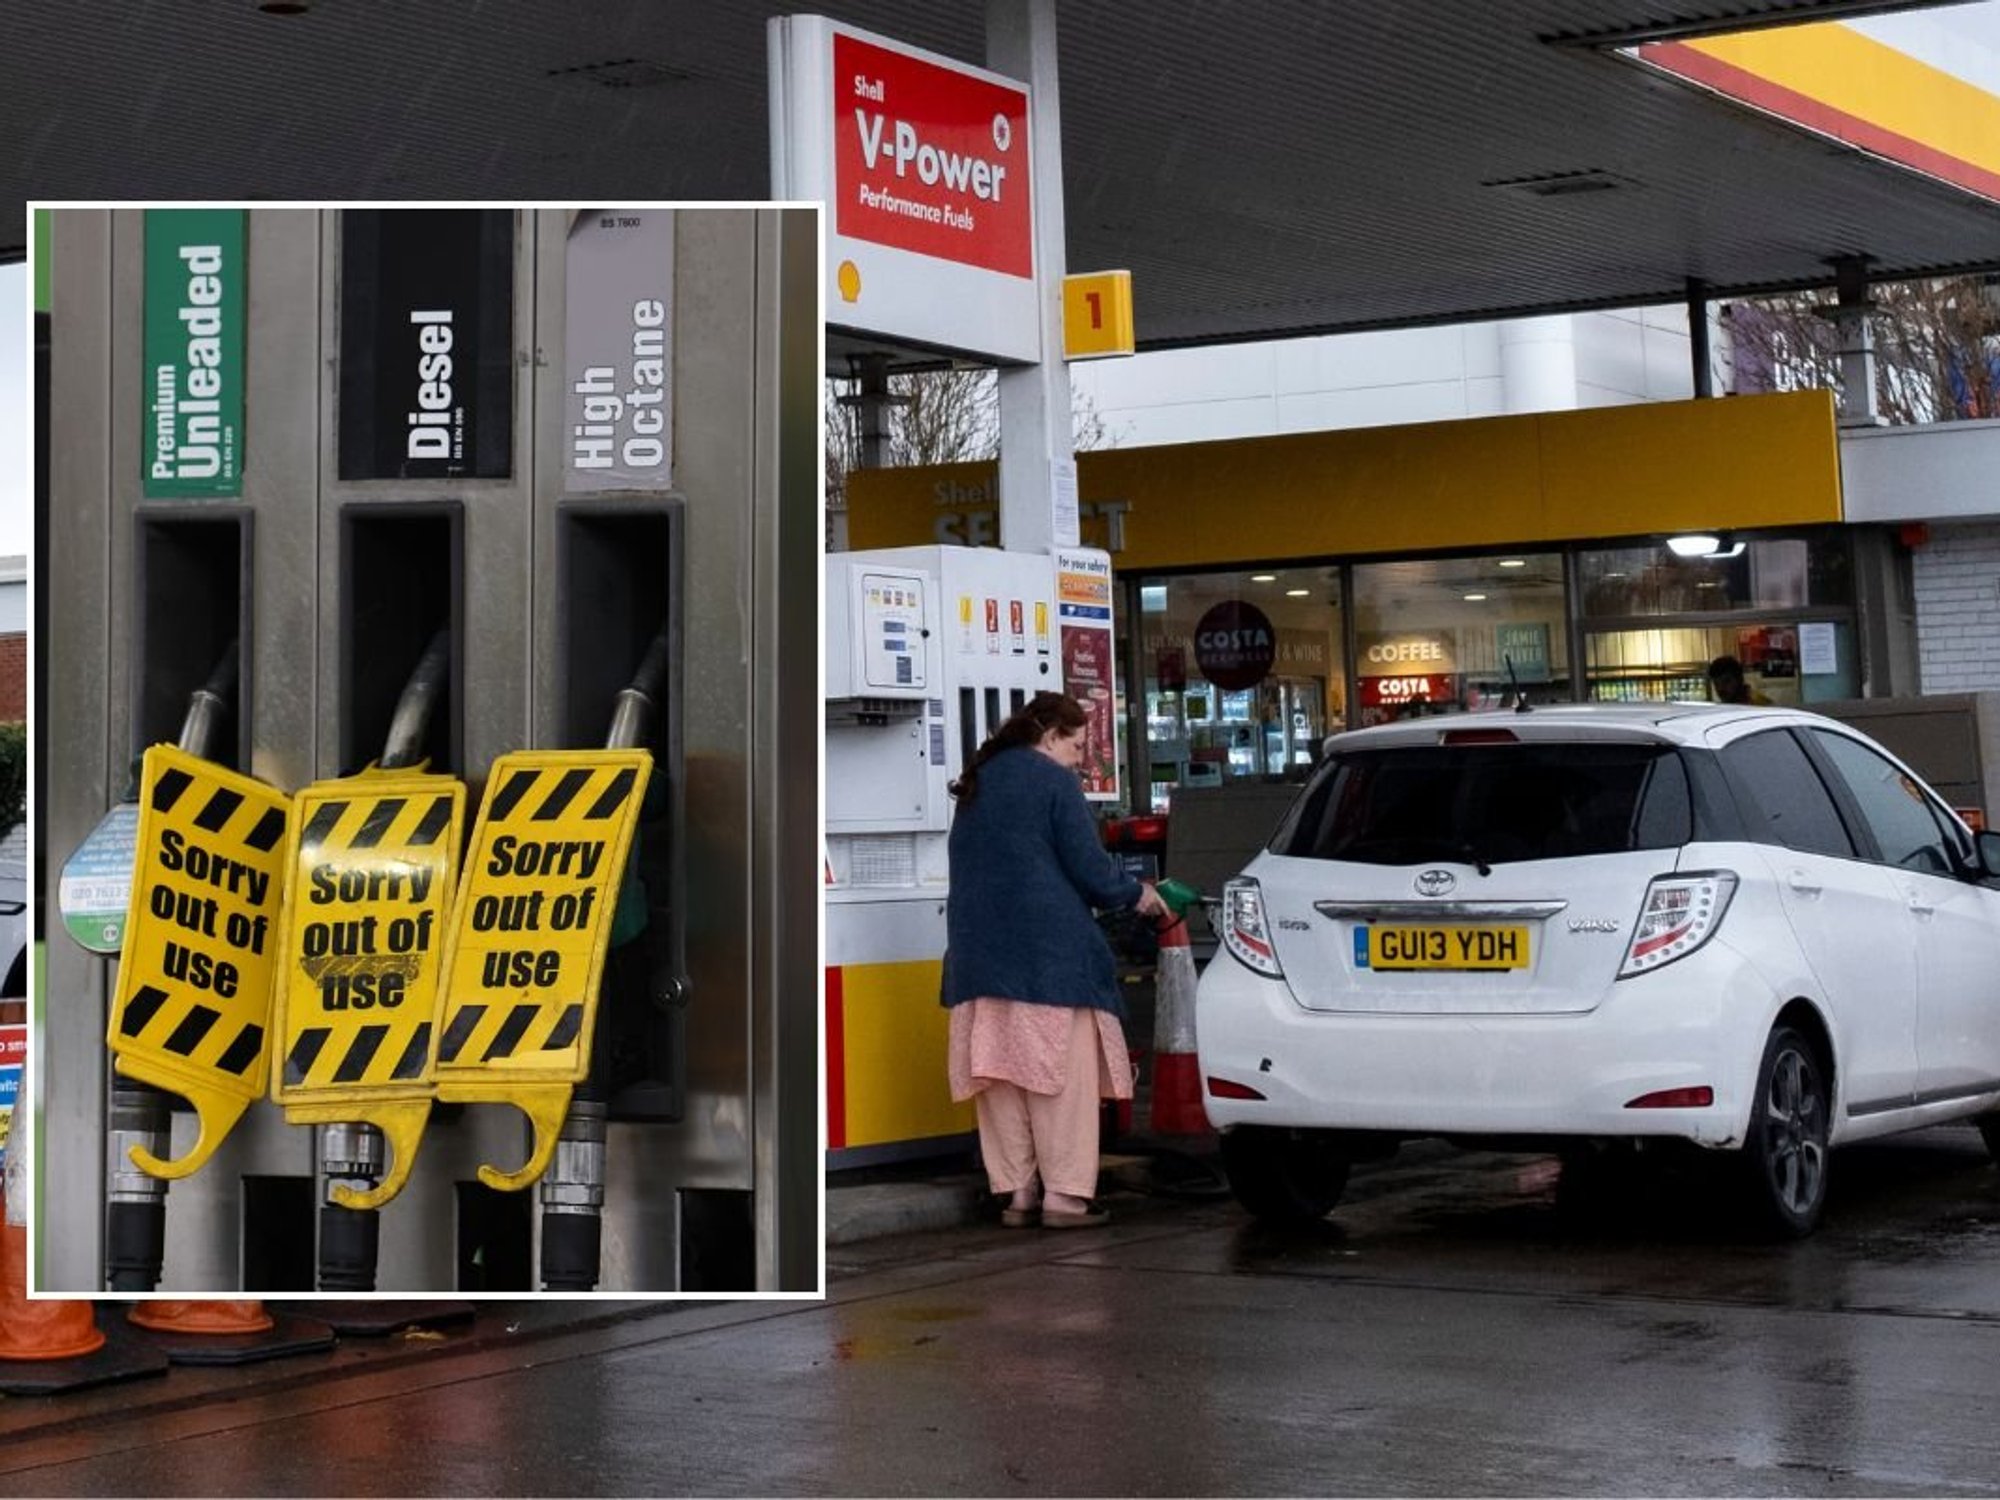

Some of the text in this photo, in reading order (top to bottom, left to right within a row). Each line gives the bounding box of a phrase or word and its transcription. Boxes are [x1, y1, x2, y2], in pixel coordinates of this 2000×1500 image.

[854, 75, 884, 101] Shell
[855, 108, 1007, 203] V-Power
[859, 183, 974, 231] Performance Fuels
[1085, 292, 1102, 330] 1
[177, 245, 223, 479] Unleaded
[408, 310, 453, 459] Diesel
[623, 298, 666, 467] Octane
[152, 365, 176, 479] Premium
[575, 366, 624, 469] High
[1071, 559, 1087, 570] your
[1200, 629, 1269, 650] COSTA
[1368, 642, 1442, 663] COFFEE
[1378, 678, 1431, 695] COSTA
[160, 828, 270, 907] Sorry
[487, 835, 605, 880] Sorry
[310, 862, 433, 905] Sorry
[150, 884, 268, 956] out of
[303, 910, 433, 956] out of
[472, 887, 597, 933] out of
[1381, 930, 1518, 961] GU13 YDH
[163, 941, 239, 999] use
[322, 971, 405, 1012] use
[482, 948, 560, 990] use
